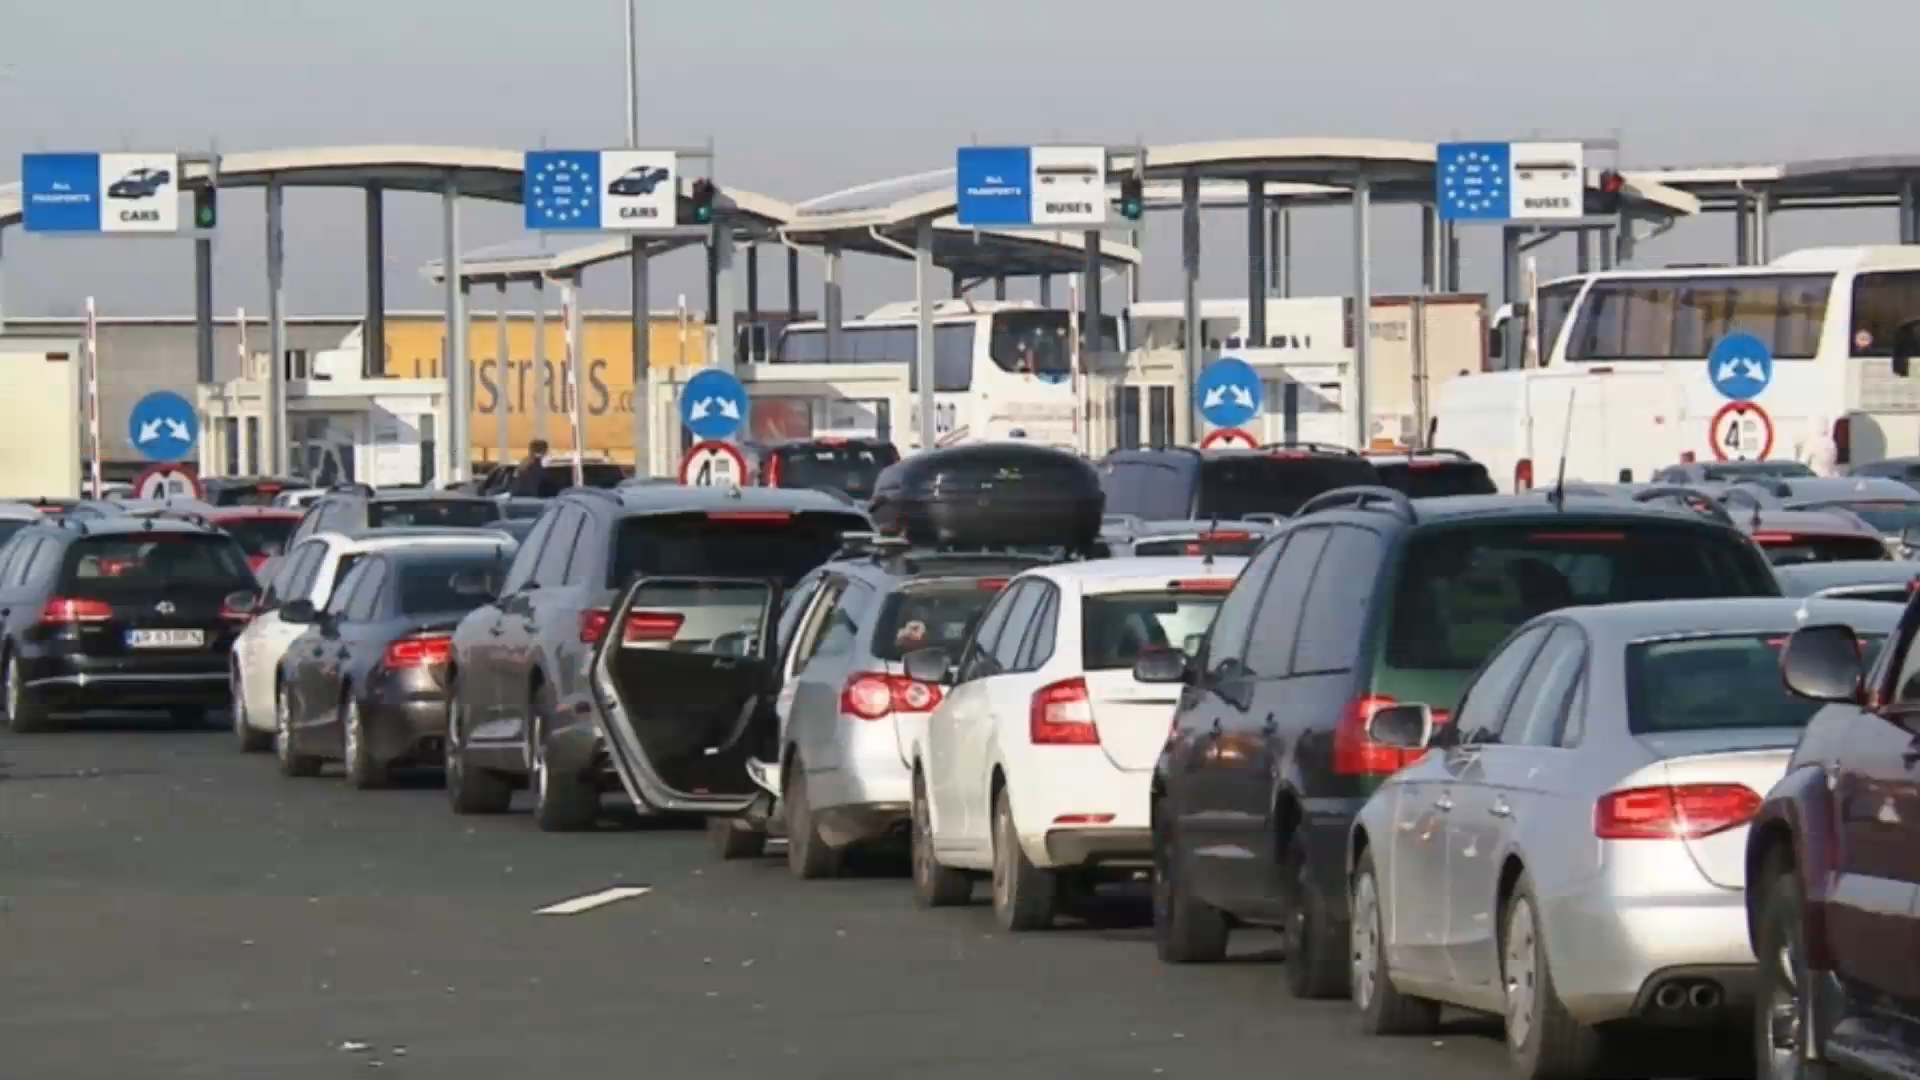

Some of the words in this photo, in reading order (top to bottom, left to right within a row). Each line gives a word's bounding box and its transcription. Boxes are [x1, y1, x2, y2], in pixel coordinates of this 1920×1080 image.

[51, 181, 72, 191] ALL
[1045, 201, 1093, 214] BUSES
[1523, 197, 1571, 209] BUSES
[119, 209, 160, 221] CARS
[619, 205, 659, 219] CARS
[1724, 420, 1740, 450] 4
